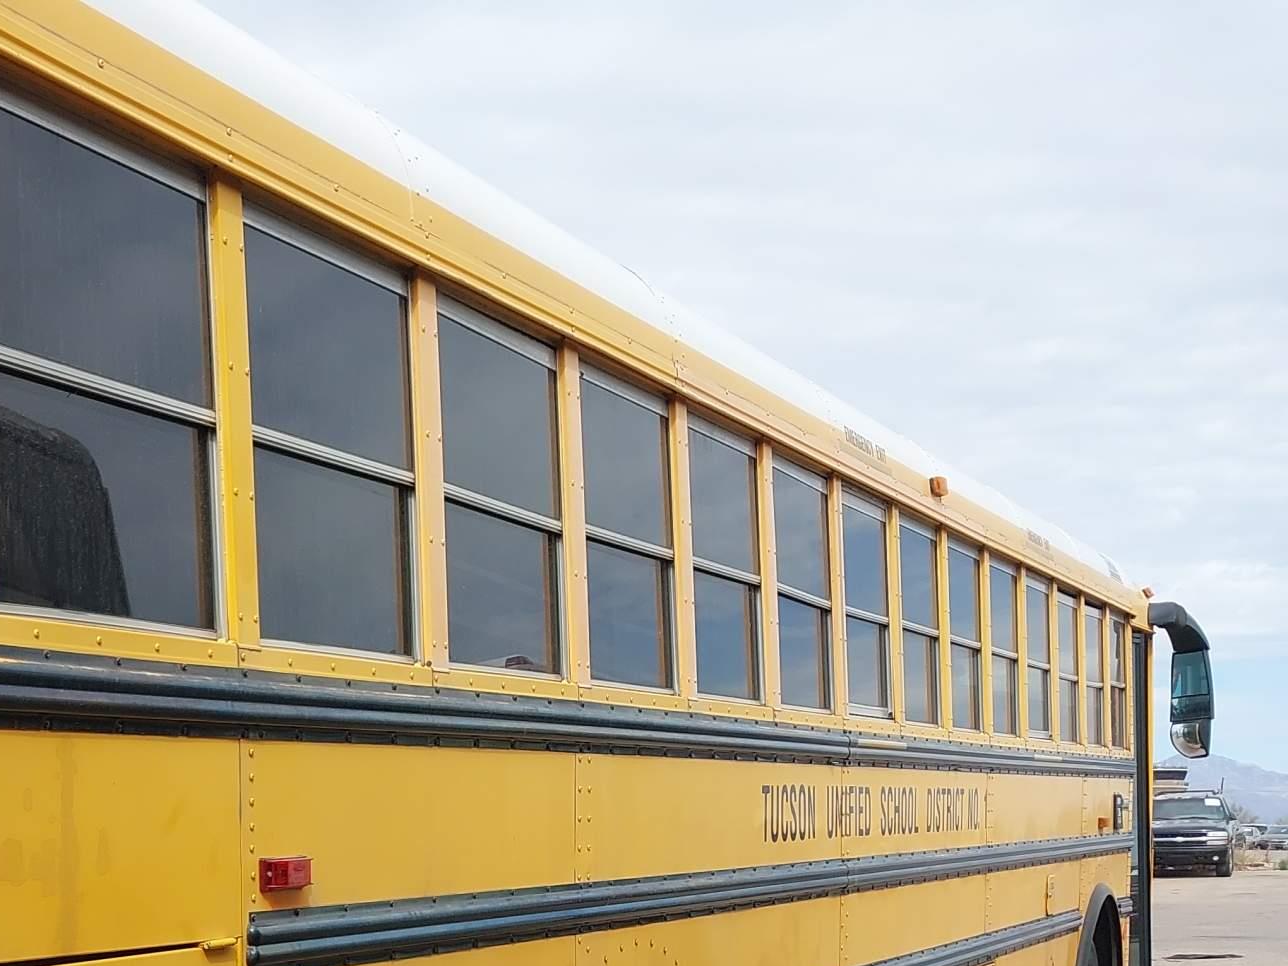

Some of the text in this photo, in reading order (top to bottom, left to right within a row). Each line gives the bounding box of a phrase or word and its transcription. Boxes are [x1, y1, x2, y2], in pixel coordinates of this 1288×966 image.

[761, 784, 816, 843] TUCSON
[826, 785, 872, 839] UNIFIED
[880, 786, 920, 836] SCHOOL
[926, 787, 965, 833] DISTRICT
[967, 787, 981, 830] NO.
